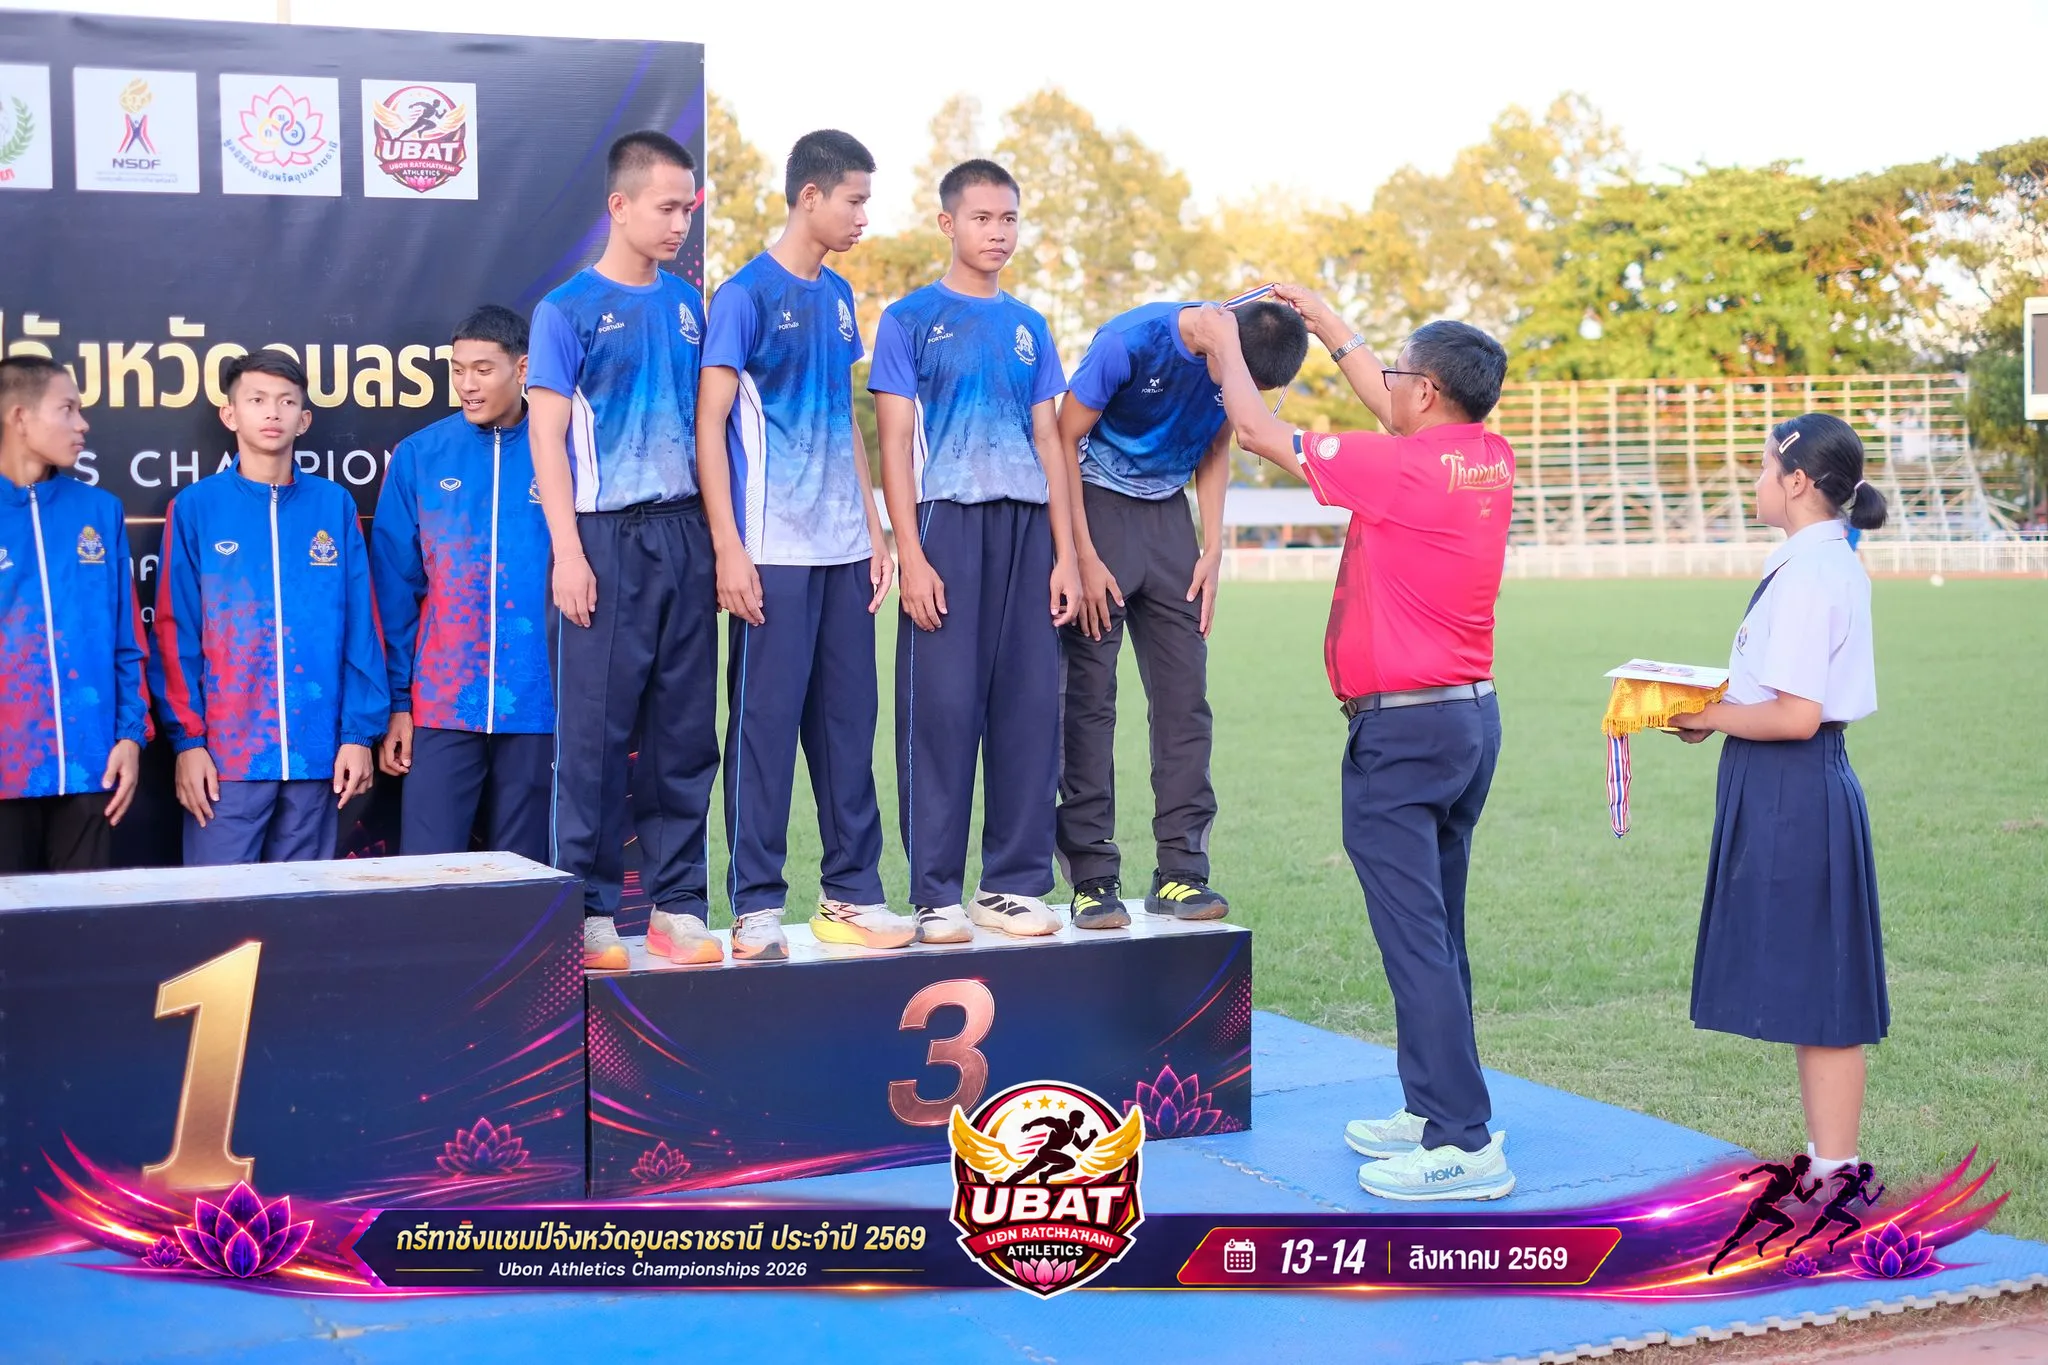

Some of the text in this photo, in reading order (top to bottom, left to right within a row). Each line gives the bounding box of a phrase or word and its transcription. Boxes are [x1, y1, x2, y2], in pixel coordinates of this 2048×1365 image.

[381, 141, 460, 162] UBAT
[112, 158, 162, 170] NSDF
[402, 169, 440, 177] ATHLETICS
[888, 978, 996, 1128] 3
[142, 941, 263, 1191] 1
[1424, 1165, 1465, 1183] HOKA
